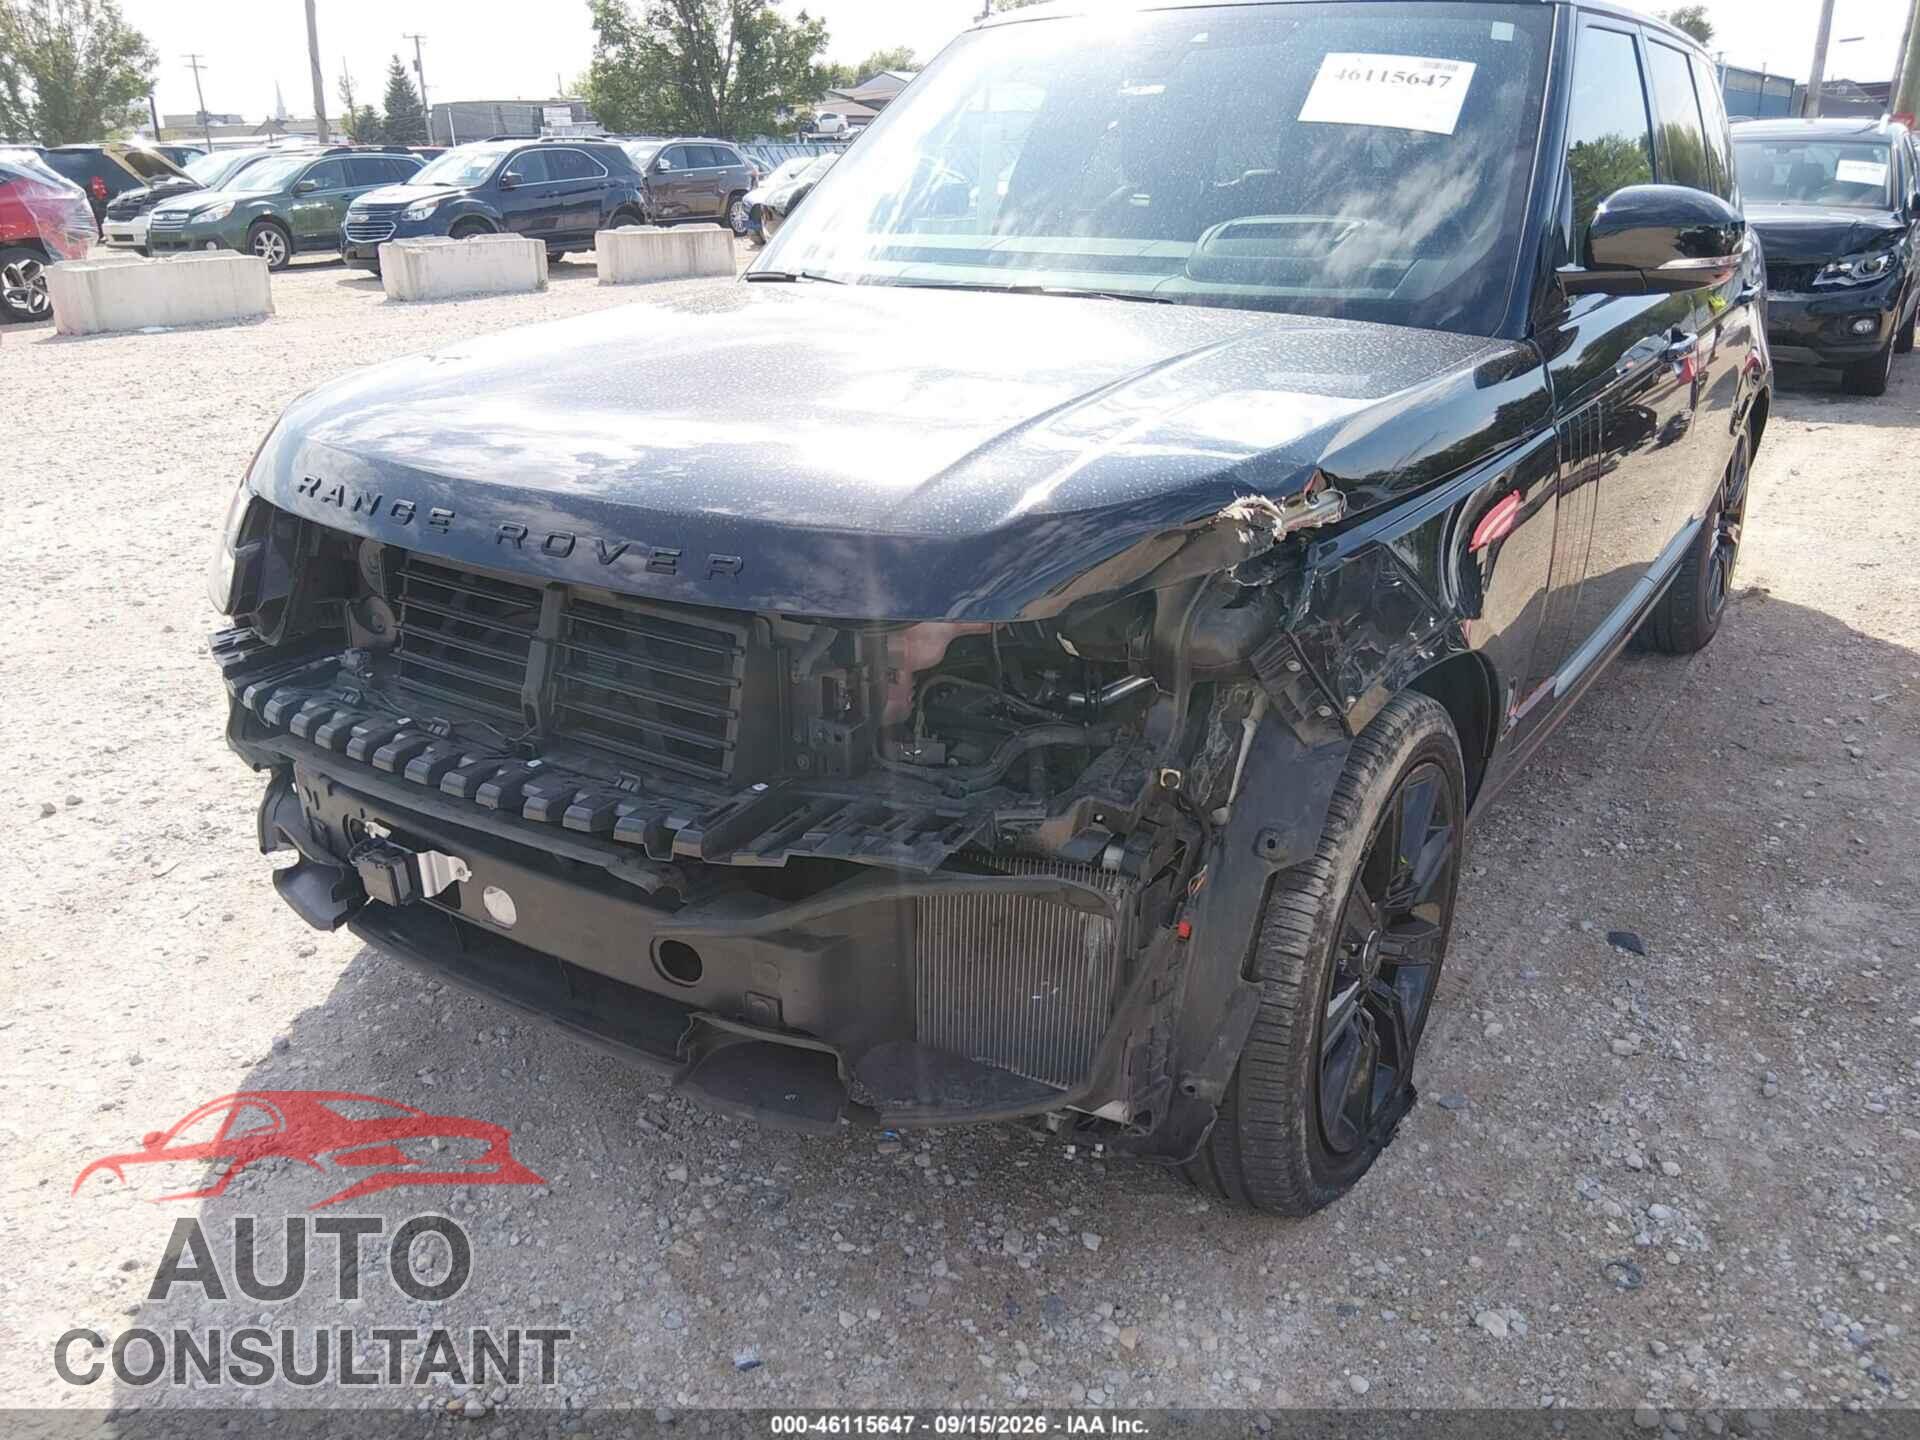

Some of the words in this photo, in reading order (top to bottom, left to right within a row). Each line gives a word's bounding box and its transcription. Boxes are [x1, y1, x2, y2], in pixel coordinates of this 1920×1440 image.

[1333, 69, 1453, 89] 46115647
[298, 474, 456, 535] RANGE
[495, 520, 745, 581] ROVER
